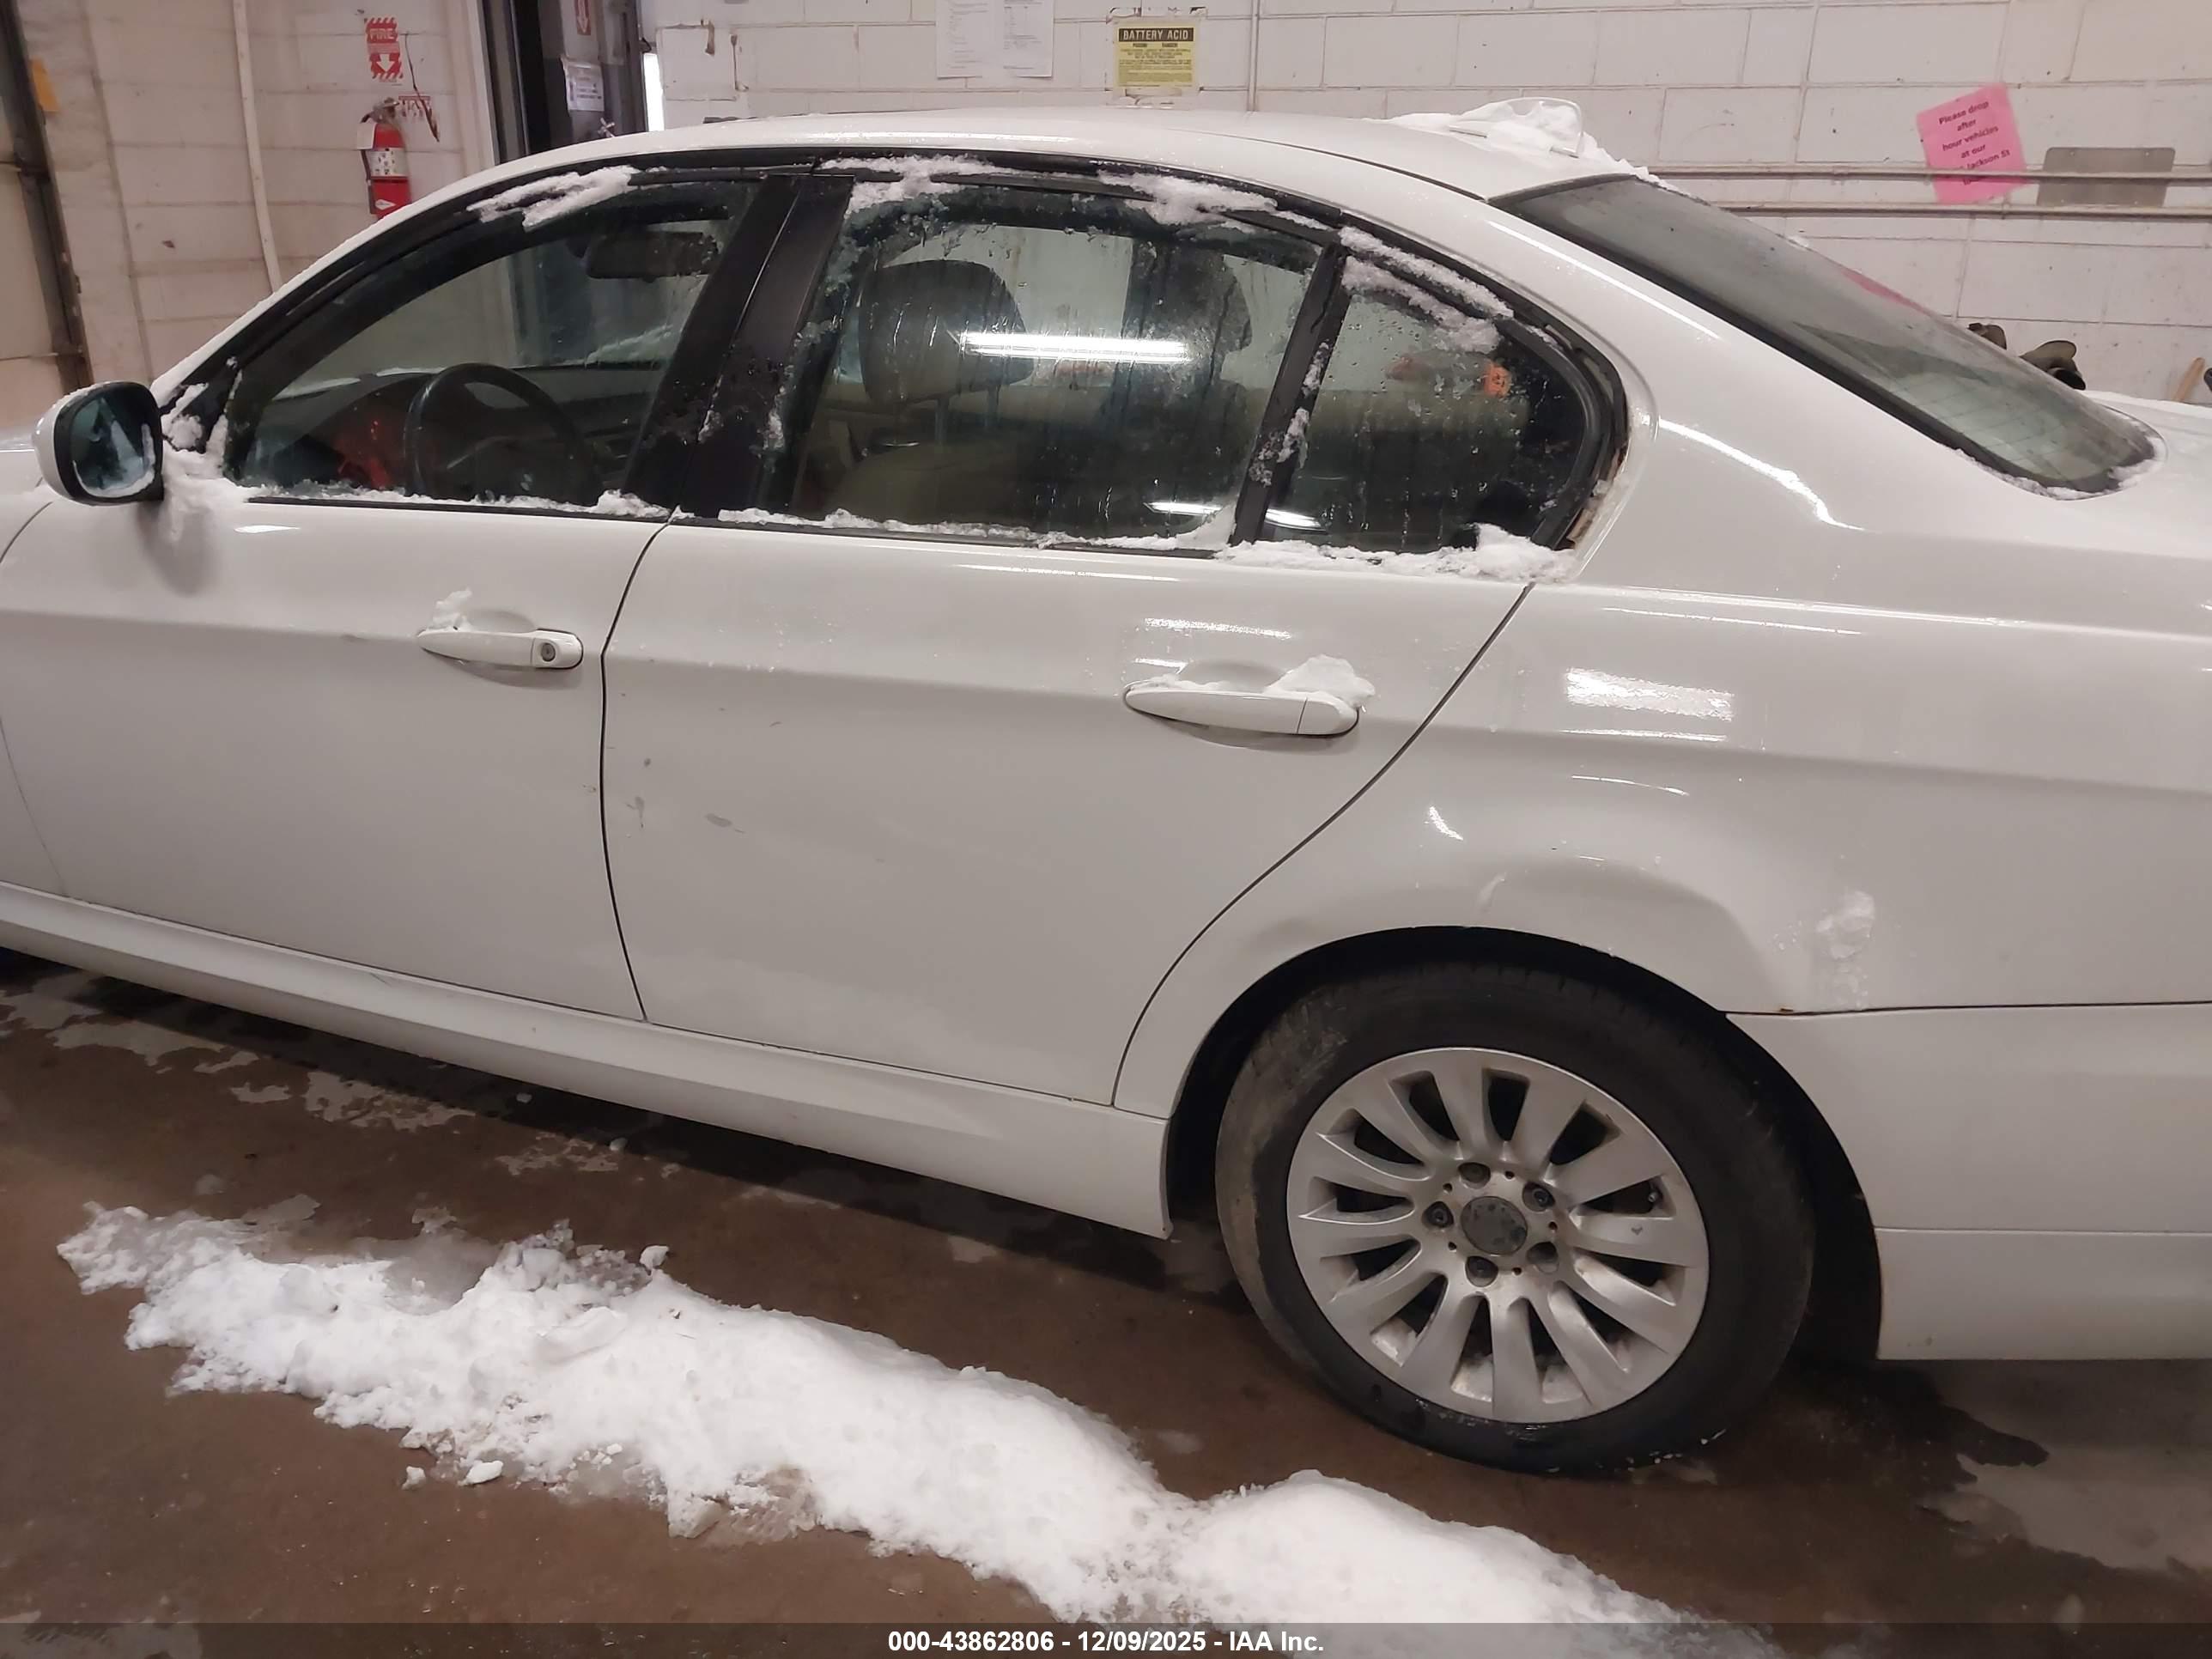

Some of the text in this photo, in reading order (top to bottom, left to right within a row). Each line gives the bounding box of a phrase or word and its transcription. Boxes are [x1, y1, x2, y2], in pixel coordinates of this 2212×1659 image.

[369, 27, 395, 40] FIRE
[1123, 29, 1188, 40] BATTERY ACID
[1938, 100, 1989, 125] Please drop
[1957, 118, 1977, 131] after
[1942, 125, 1999, 151] hour vehicles
[1960, 144, 1986, 159] at our
[2001, 149, 2011, 158] St
